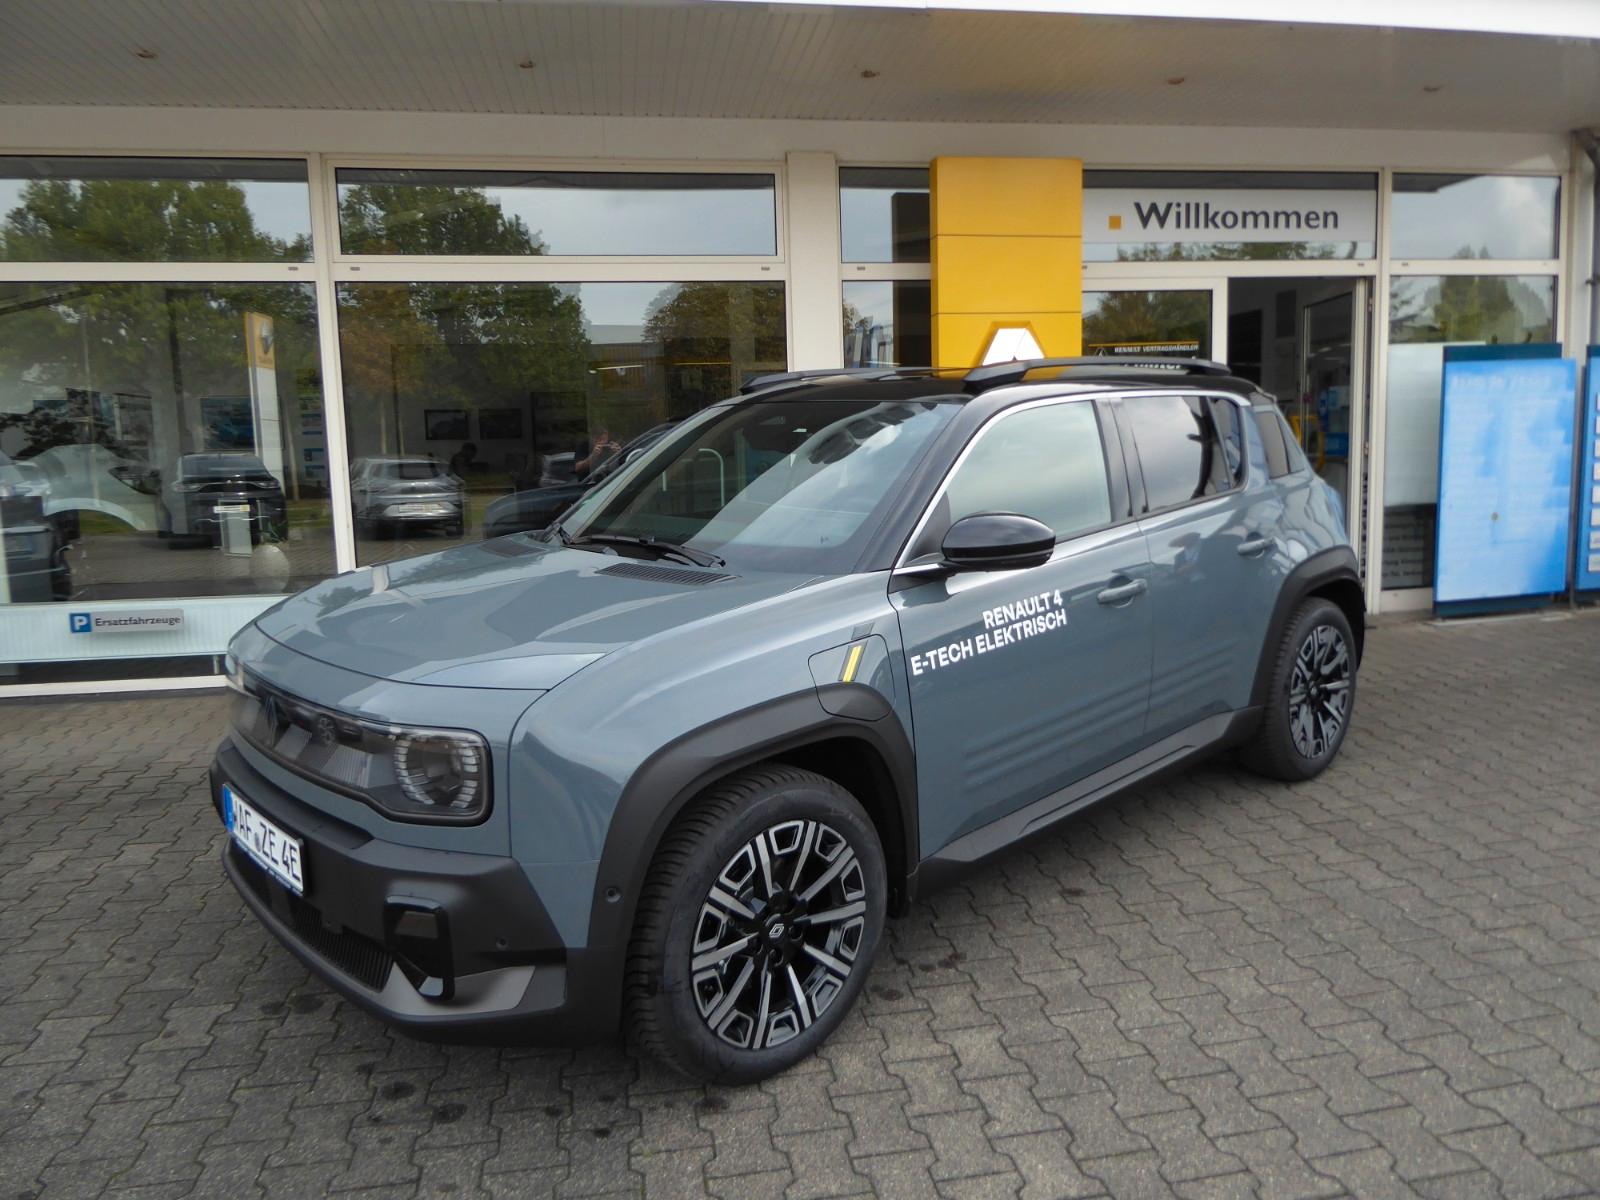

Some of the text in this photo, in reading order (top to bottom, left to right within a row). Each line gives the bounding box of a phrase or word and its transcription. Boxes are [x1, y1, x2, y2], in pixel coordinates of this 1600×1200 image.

[1133, 201, 1339, 230] Willkommen
[74, 616, 181, 630] P Ersatzfahrzeuge
[984, 589, 1063, 628] RENAULT 4
[911, 609, 1067, 675] E-TECH ELEKTRISCH
[260, 820, 279, 866] ZE
[282, 839, 301, 882] 4E
